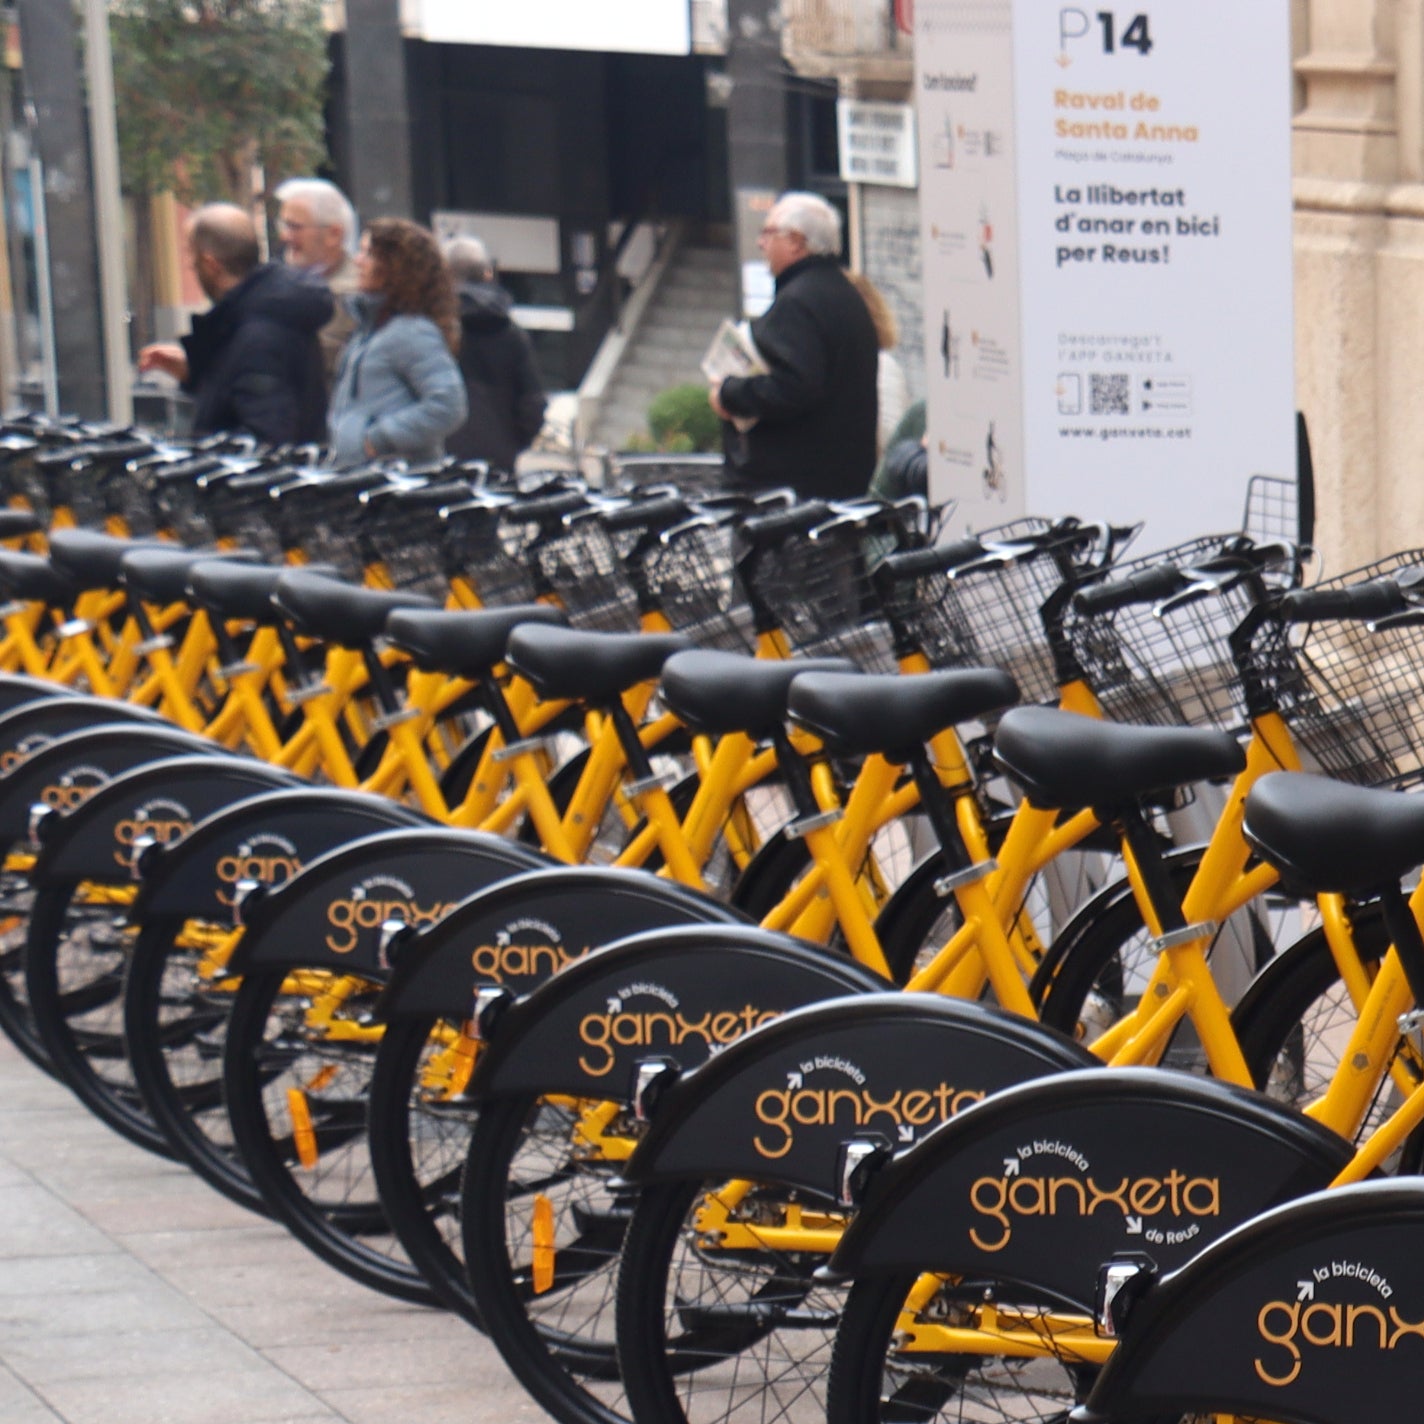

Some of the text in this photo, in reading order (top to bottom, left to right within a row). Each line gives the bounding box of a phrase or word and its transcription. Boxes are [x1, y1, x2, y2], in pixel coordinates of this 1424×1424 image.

[1059, 8, 1153, 56] P14
[1054, 89, 1160, 111] Raval de
[1055, 119, 1199, 142] Santa Anna
[1054, 184, 1185, 206] La llibertat
[1141, 221, 1170, 235] en
[1176, 215, 1219, 236] bici
[1056, 244, 1170, 268] per Reus!
[800, 1055, 866, 1086] la bicicleta
[1017, 1139, 1090, 1172] la bicicleta
[968, 1168, 1220, 1252] ganxeta
[1145, 1222, 1200, 1245] de Reus
[1312, 1260, 1394, 1300] la bicicleta
